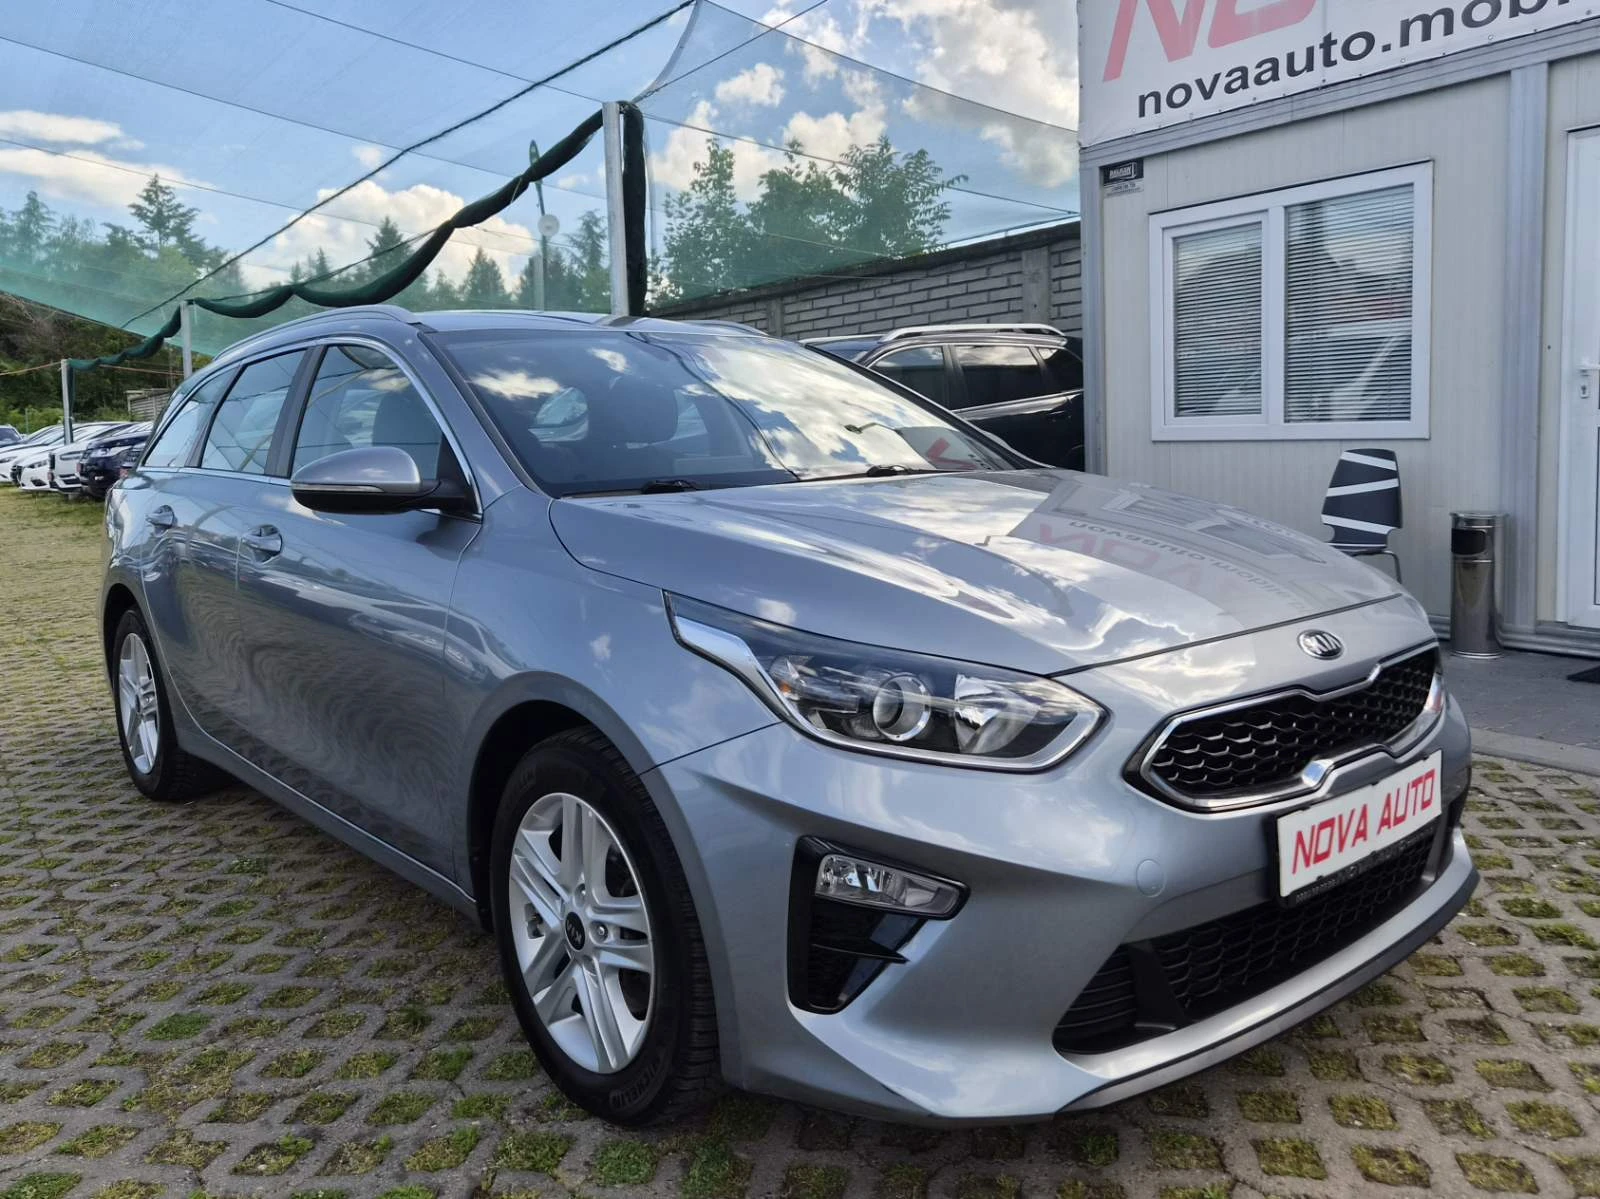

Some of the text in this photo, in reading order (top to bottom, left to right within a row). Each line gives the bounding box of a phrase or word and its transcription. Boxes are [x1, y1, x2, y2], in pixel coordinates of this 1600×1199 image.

[1138, 0, 1570, 118] novaauto.mo
[1292, 804, 1368, 875] NOVA
[1377, 769, 1436, 835] AUTO
